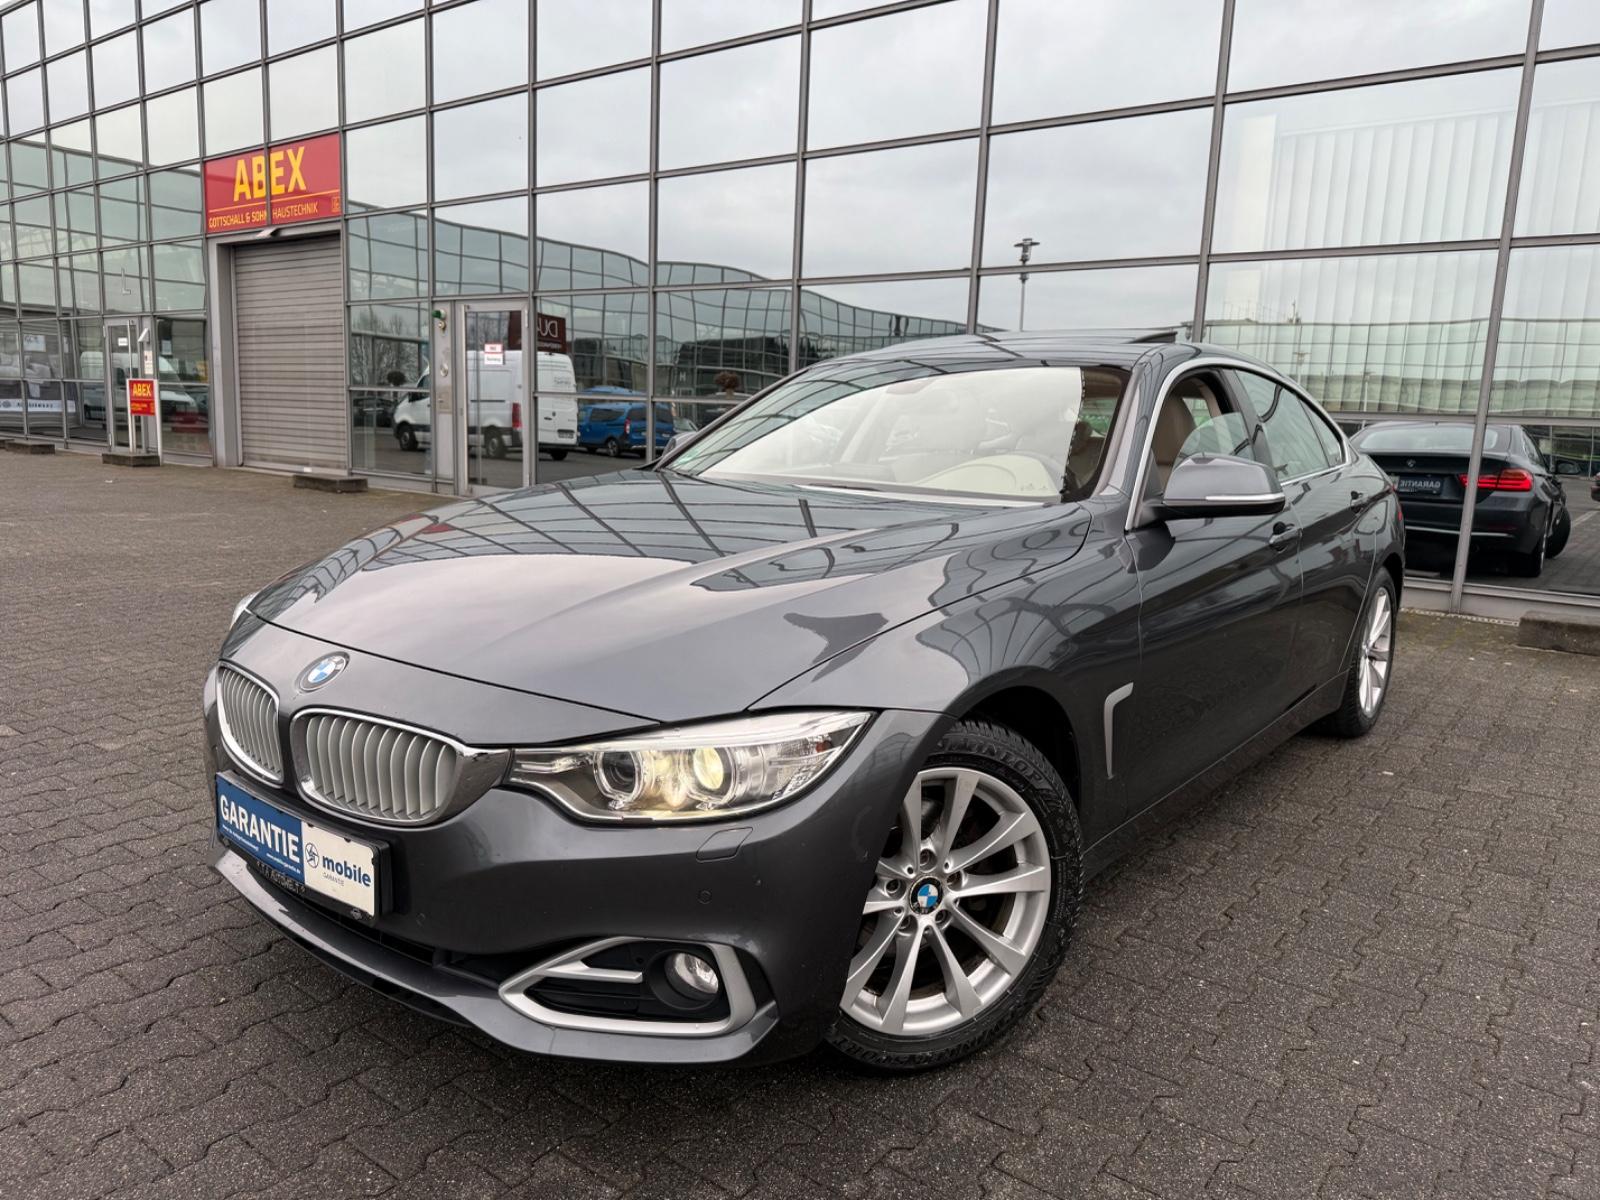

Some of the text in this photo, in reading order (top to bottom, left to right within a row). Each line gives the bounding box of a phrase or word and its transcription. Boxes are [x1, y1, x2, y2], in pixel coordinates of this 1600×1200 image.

[234, 147, 307, 201] ABEX
[208, 214, 245, 227] GOTTSCHALL
[246, 211, 251, 223] &
[273, 202, 318, 218] HAUSTECHNIK
[132, 383, 152, 397] ABEX
[219, 794, 300, 864] GARANTIE
[322, 854, 372, 887] mobile
